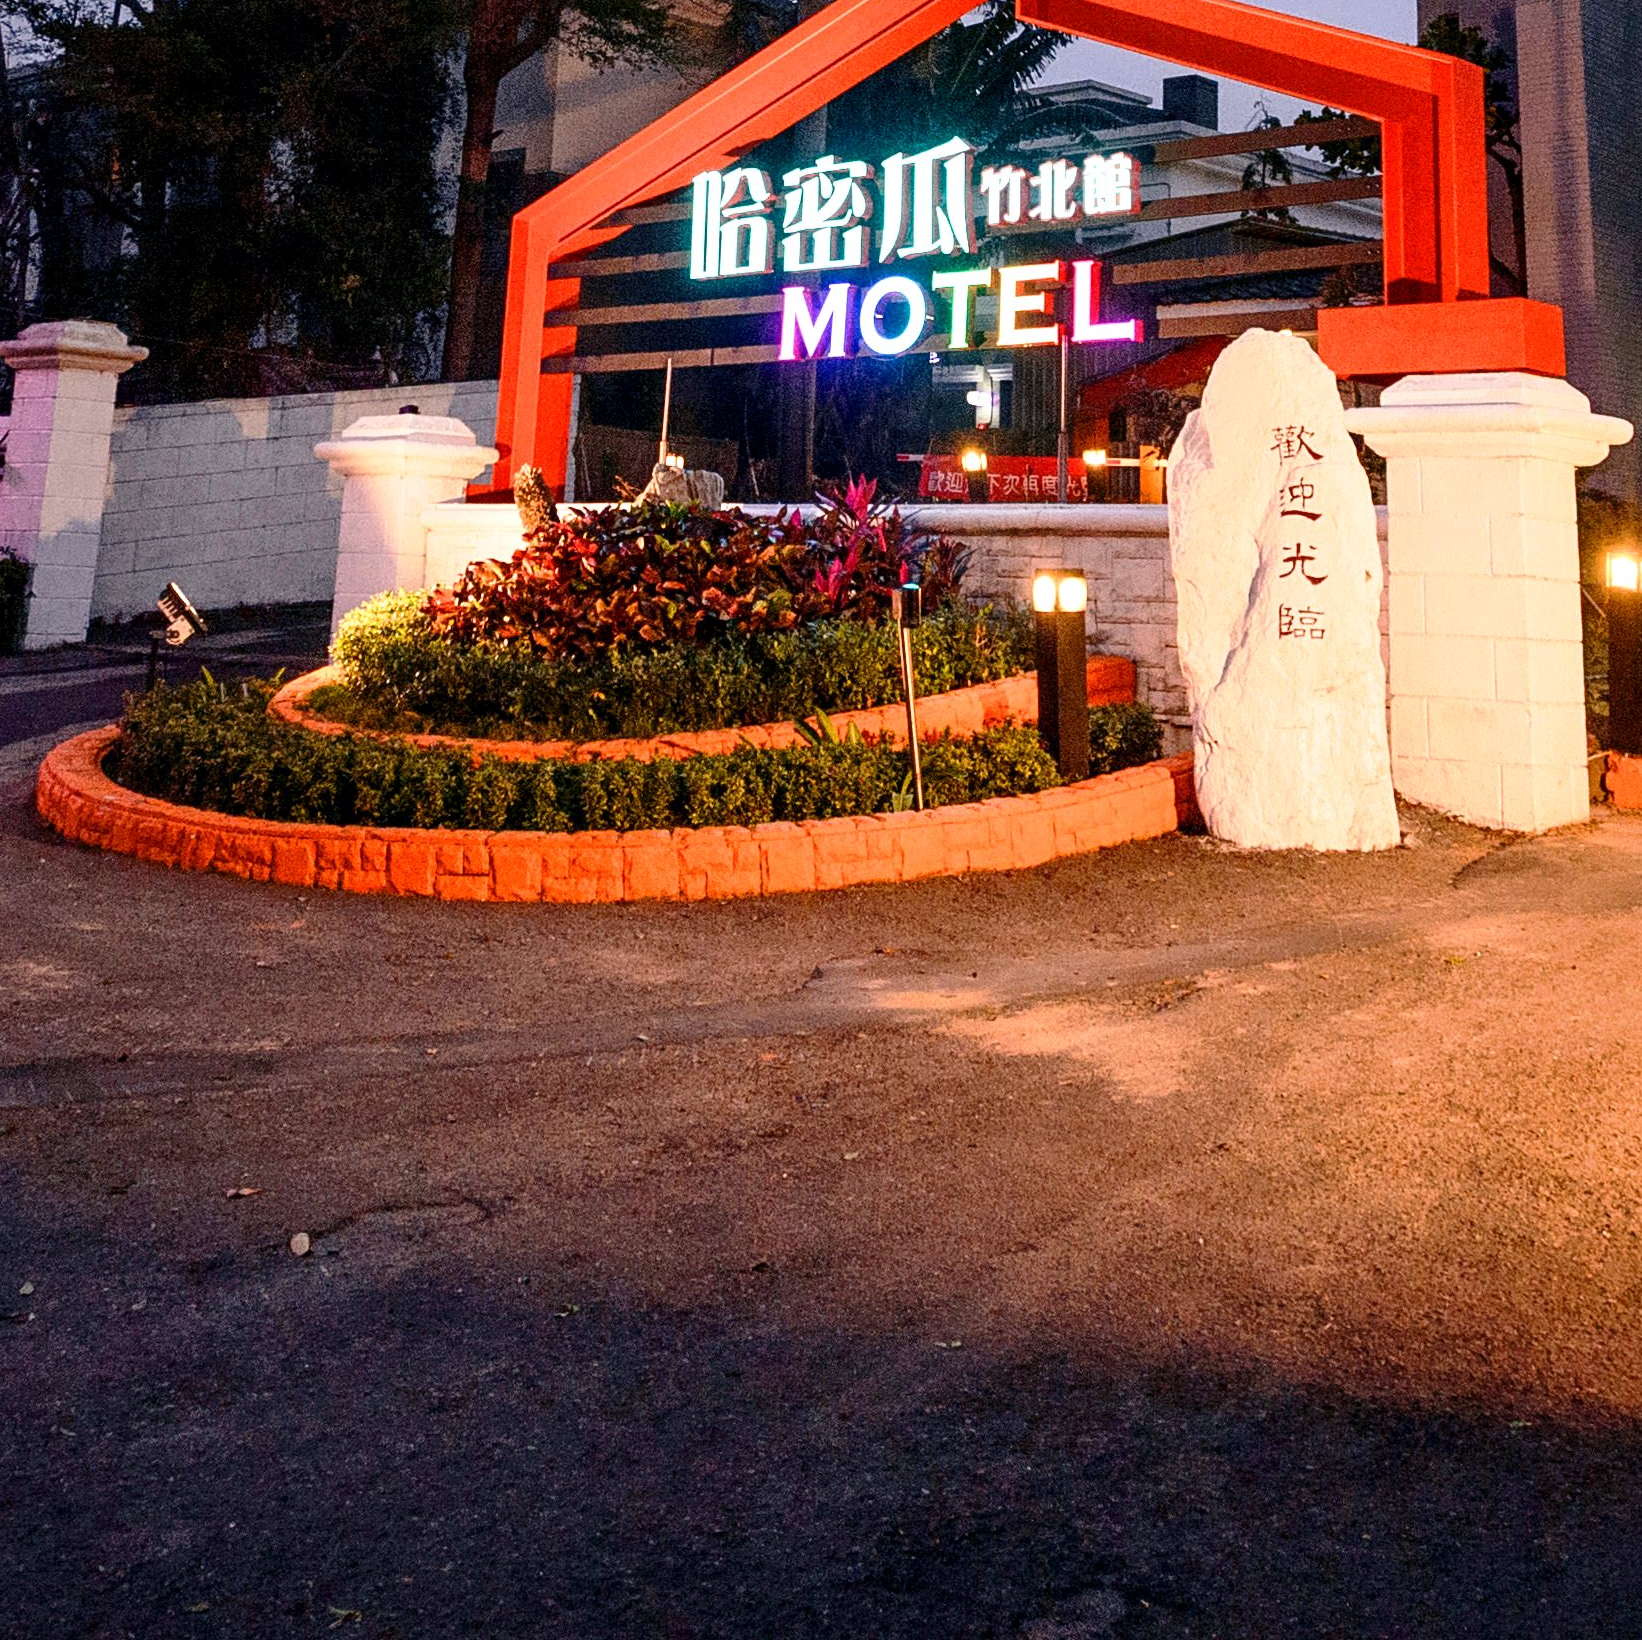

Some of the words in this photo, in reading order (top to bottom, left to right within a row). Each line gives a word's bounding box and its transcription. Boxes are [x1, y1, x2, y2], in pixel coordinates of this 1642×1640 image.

[689, 136, 975, 280] 哈密瓜
[980, 151, 1140, 226] 竹北館
[778, 258, 1144, 361] MOTEL
[1269, 423, 1328, 641] 歡迎光臨
